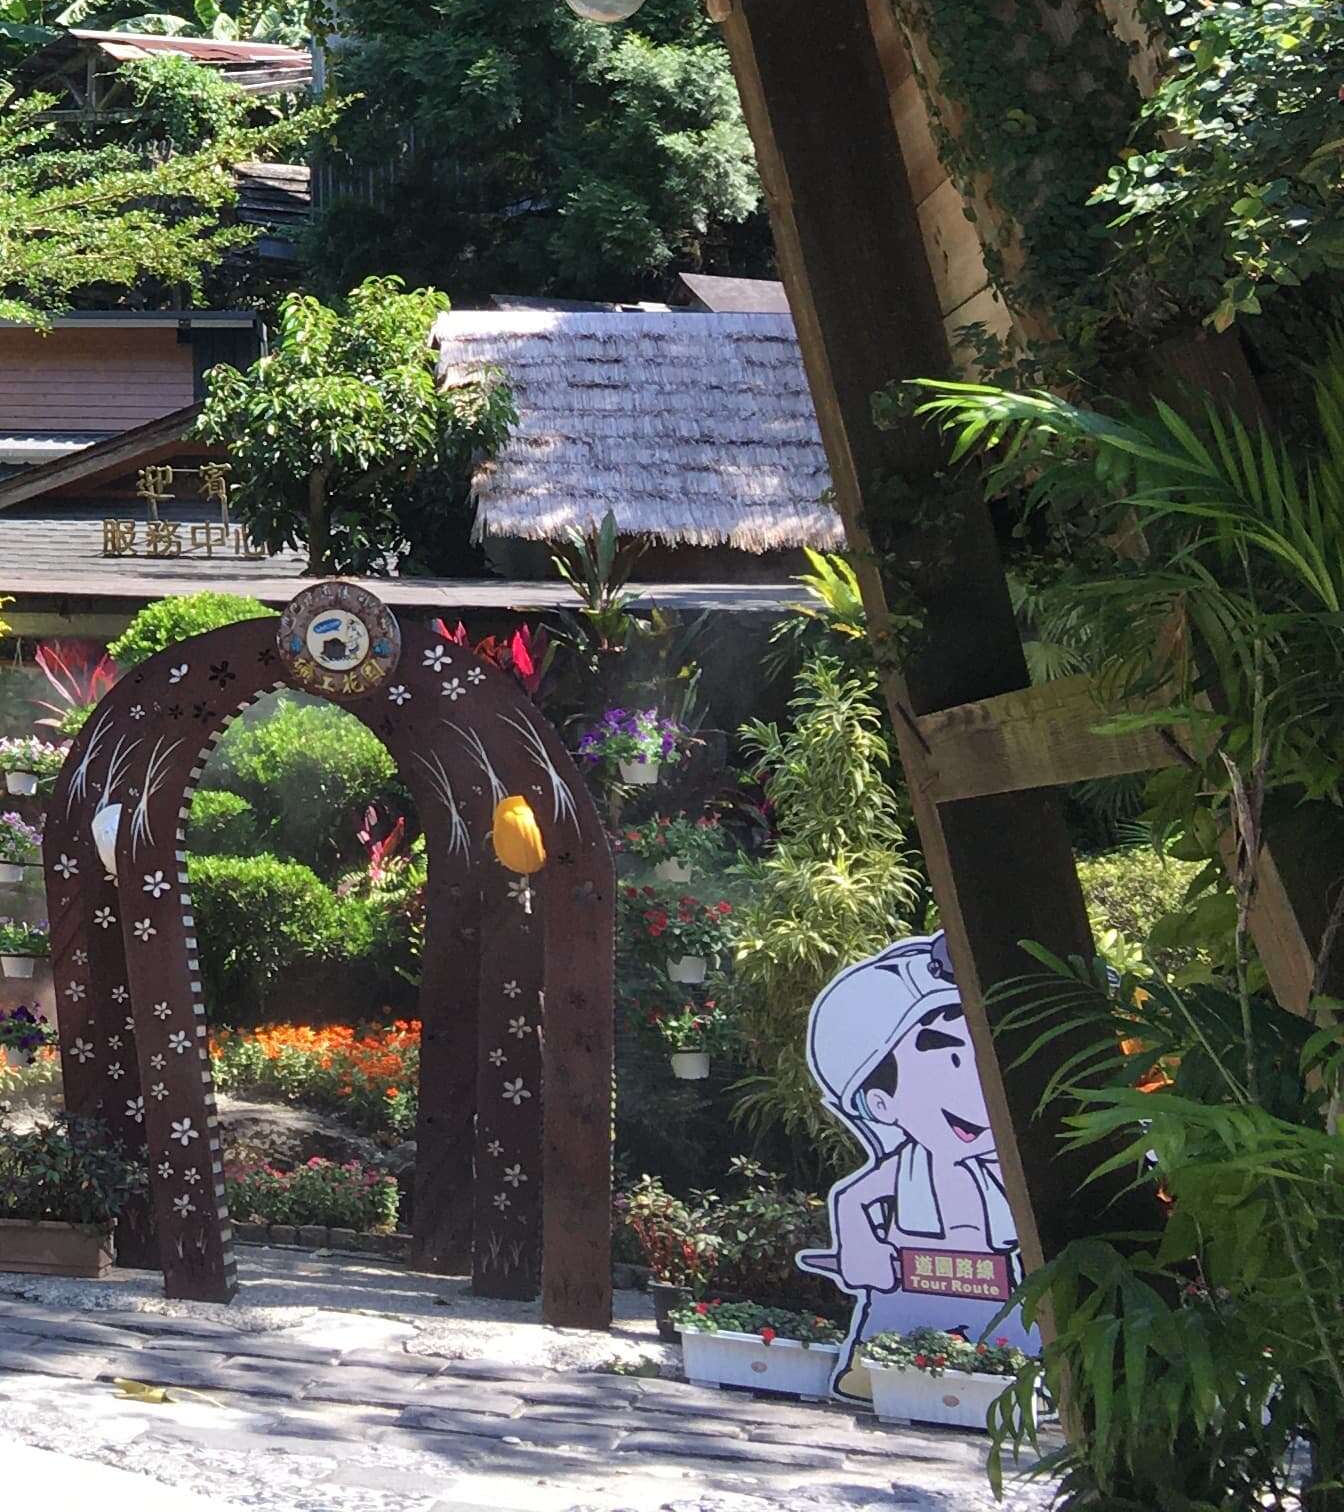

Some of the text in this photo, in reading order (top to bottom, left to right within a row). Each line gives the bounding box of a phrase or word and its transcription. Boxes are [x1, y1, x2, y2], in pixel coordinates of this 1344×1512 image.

[103, 519, 270, 557] 服務中心
[914, 1255, 995, 1280] 遊園路線
[910, 1276, 1000, 1296] Tour Route
